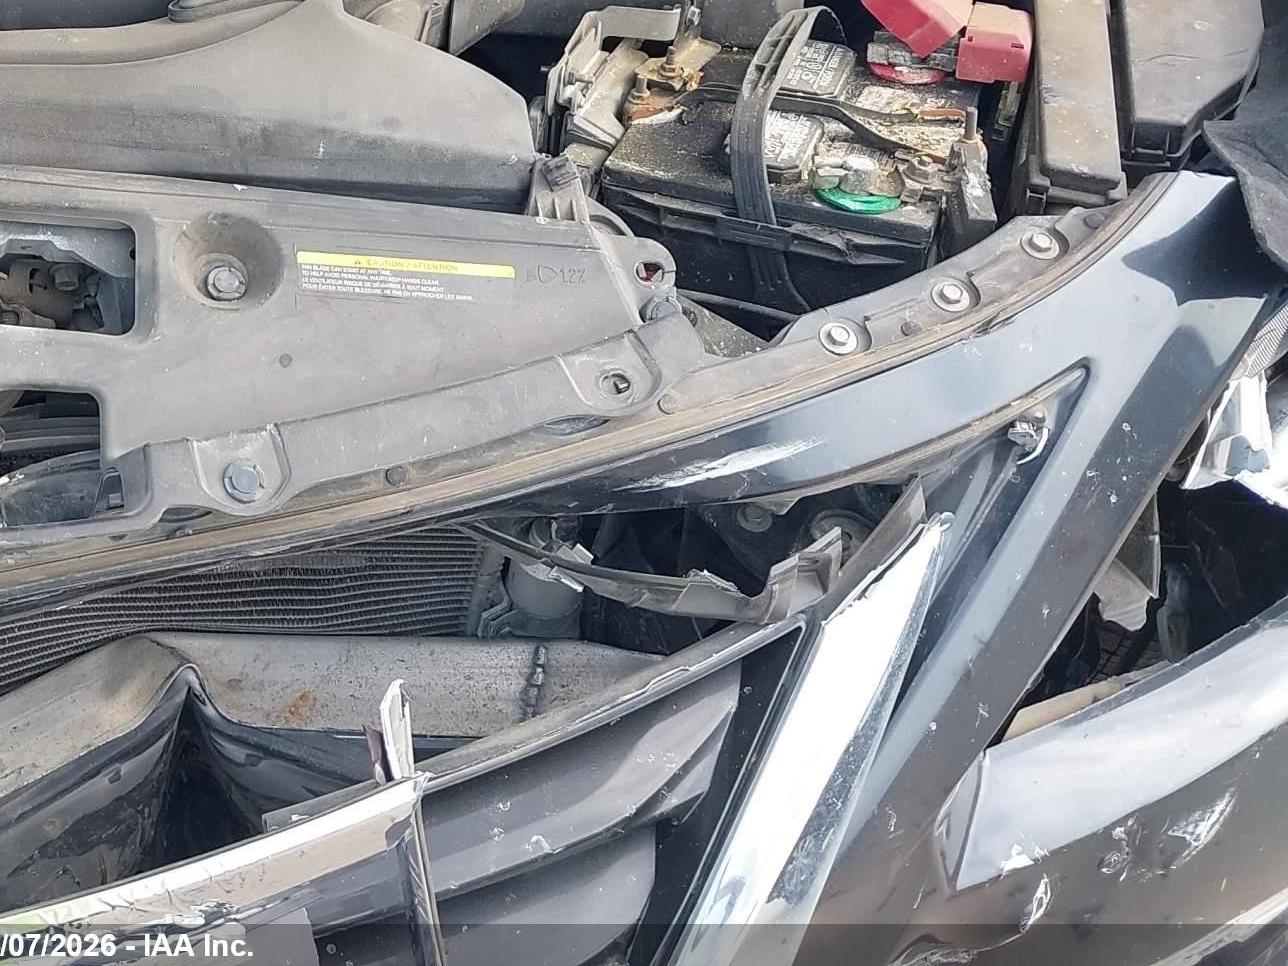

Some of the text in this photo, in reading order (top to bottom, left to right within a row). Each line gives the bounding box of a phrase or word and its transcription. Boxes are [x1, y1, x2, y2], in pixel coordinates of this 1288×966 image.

[367, 259, 402, 267] CAUTION
[412, 262, 457, 271] ATTENTION
[341, 272, 368, 280] PERSONAL
